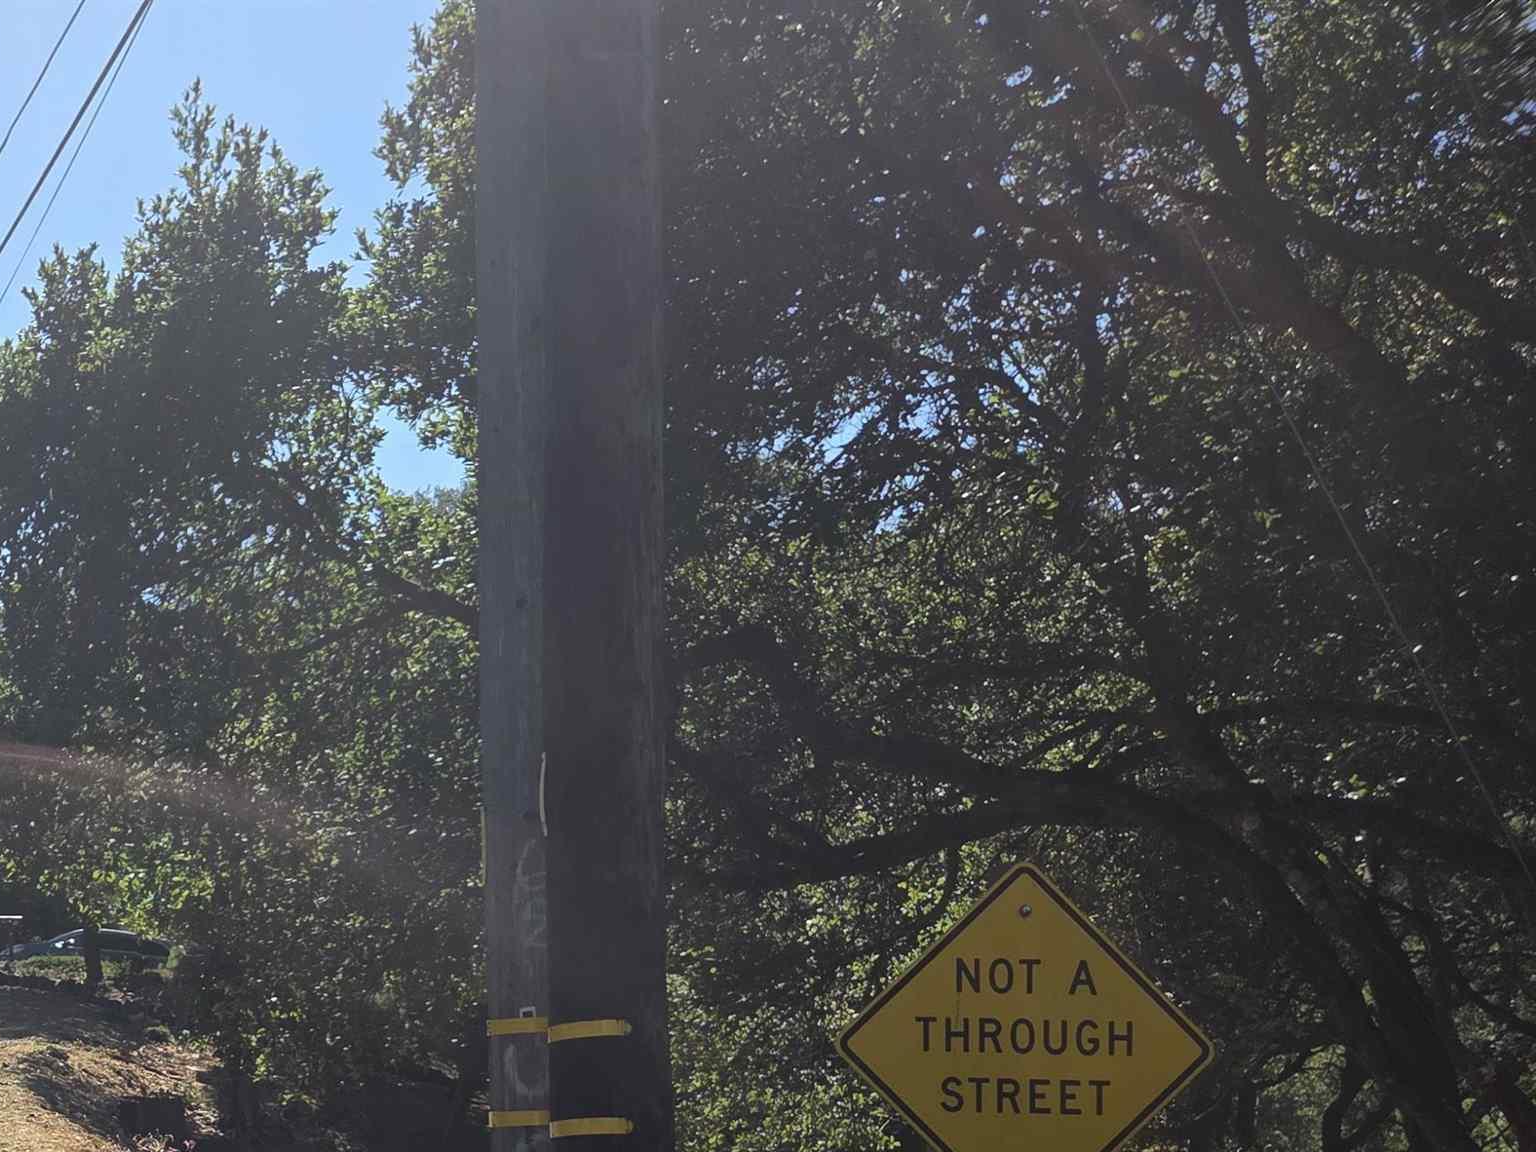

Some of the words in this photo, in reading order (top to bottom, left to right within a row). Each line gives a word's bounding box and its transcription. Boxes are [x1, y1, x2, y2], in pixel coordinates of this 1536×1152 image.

[955, 957, 1041, 994] NOT
[1068, 959, 1098, 996] A
[914, 1016, 1134, 1057] THROUGH
[940, 1076, 1111, 1116] STREET
